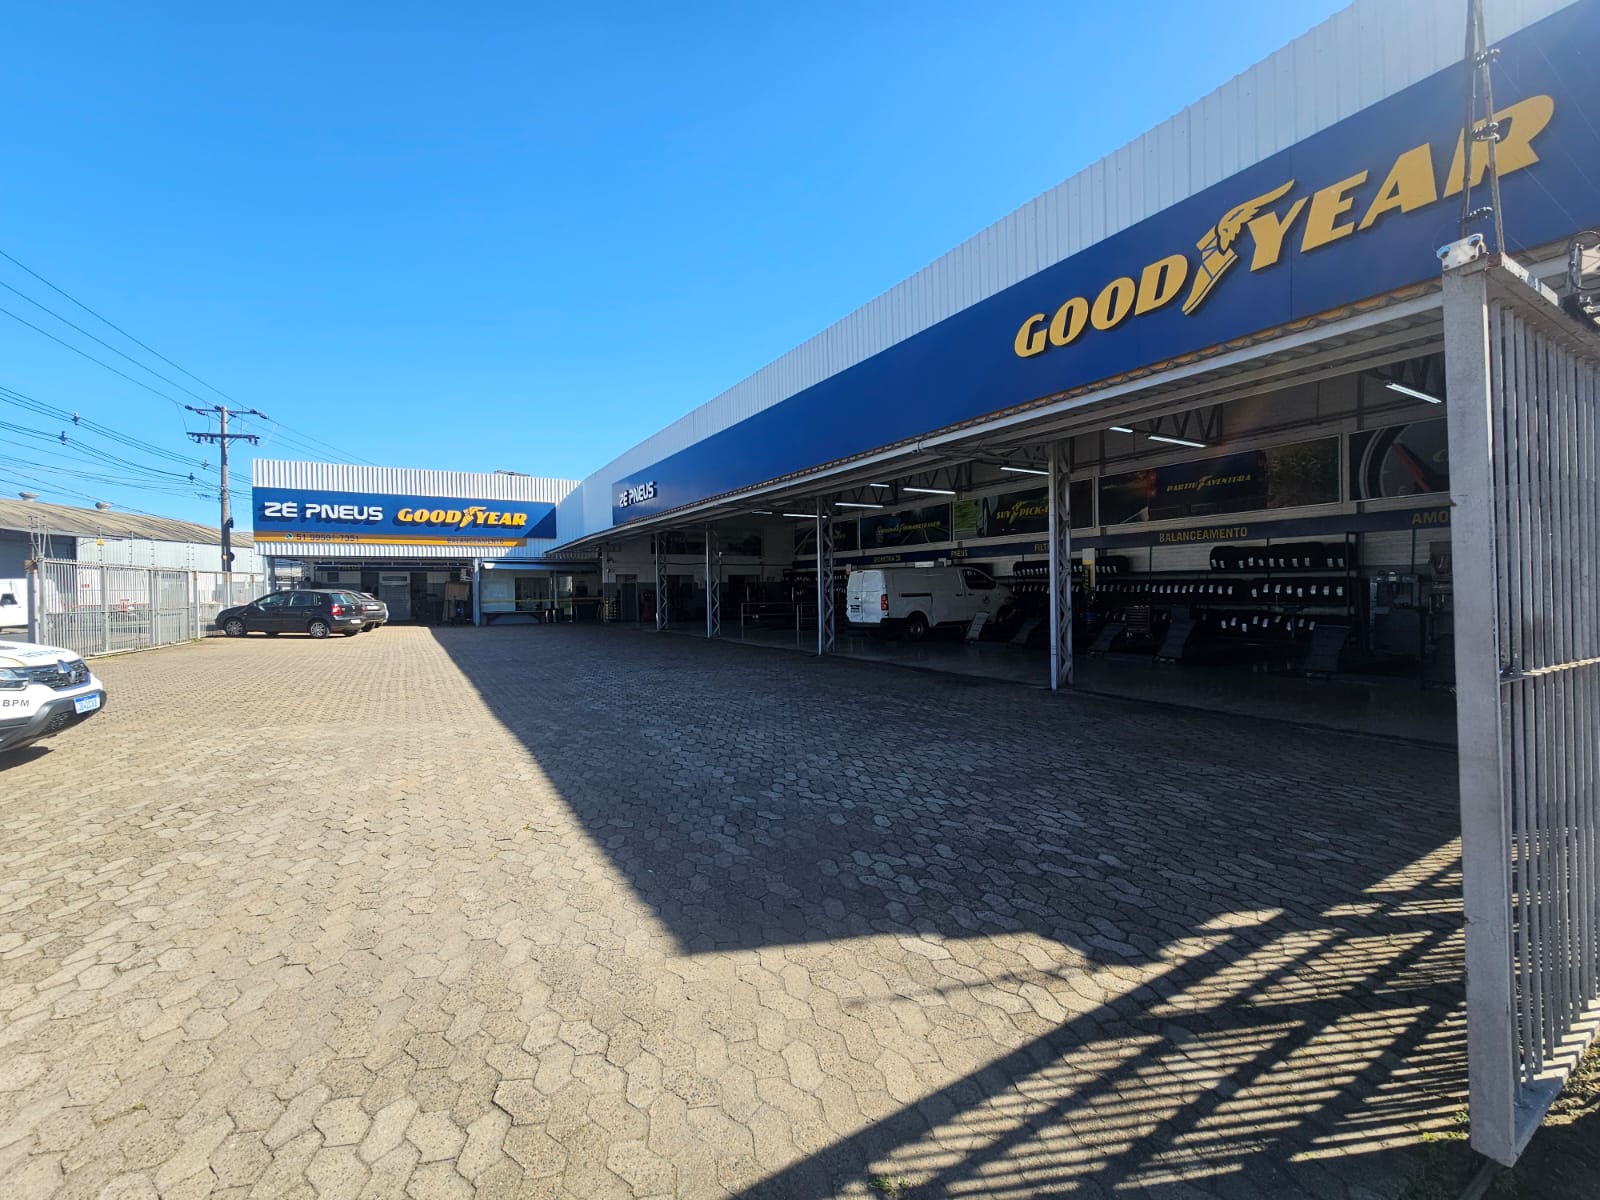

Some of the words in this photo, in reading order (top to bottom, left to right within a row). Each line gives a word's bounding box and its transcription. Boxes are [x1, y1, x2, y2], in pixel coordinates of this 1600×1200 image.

[1014, 94, 1555, 358] GOODYEAR
[628, 480, 654, 504] PNEUS
[305, 503, 384, 520] PNEUS
[397, 506, 528, 527] GOODYEAR
[1159, 527, 1248, 543] BALANCEAMENTO
